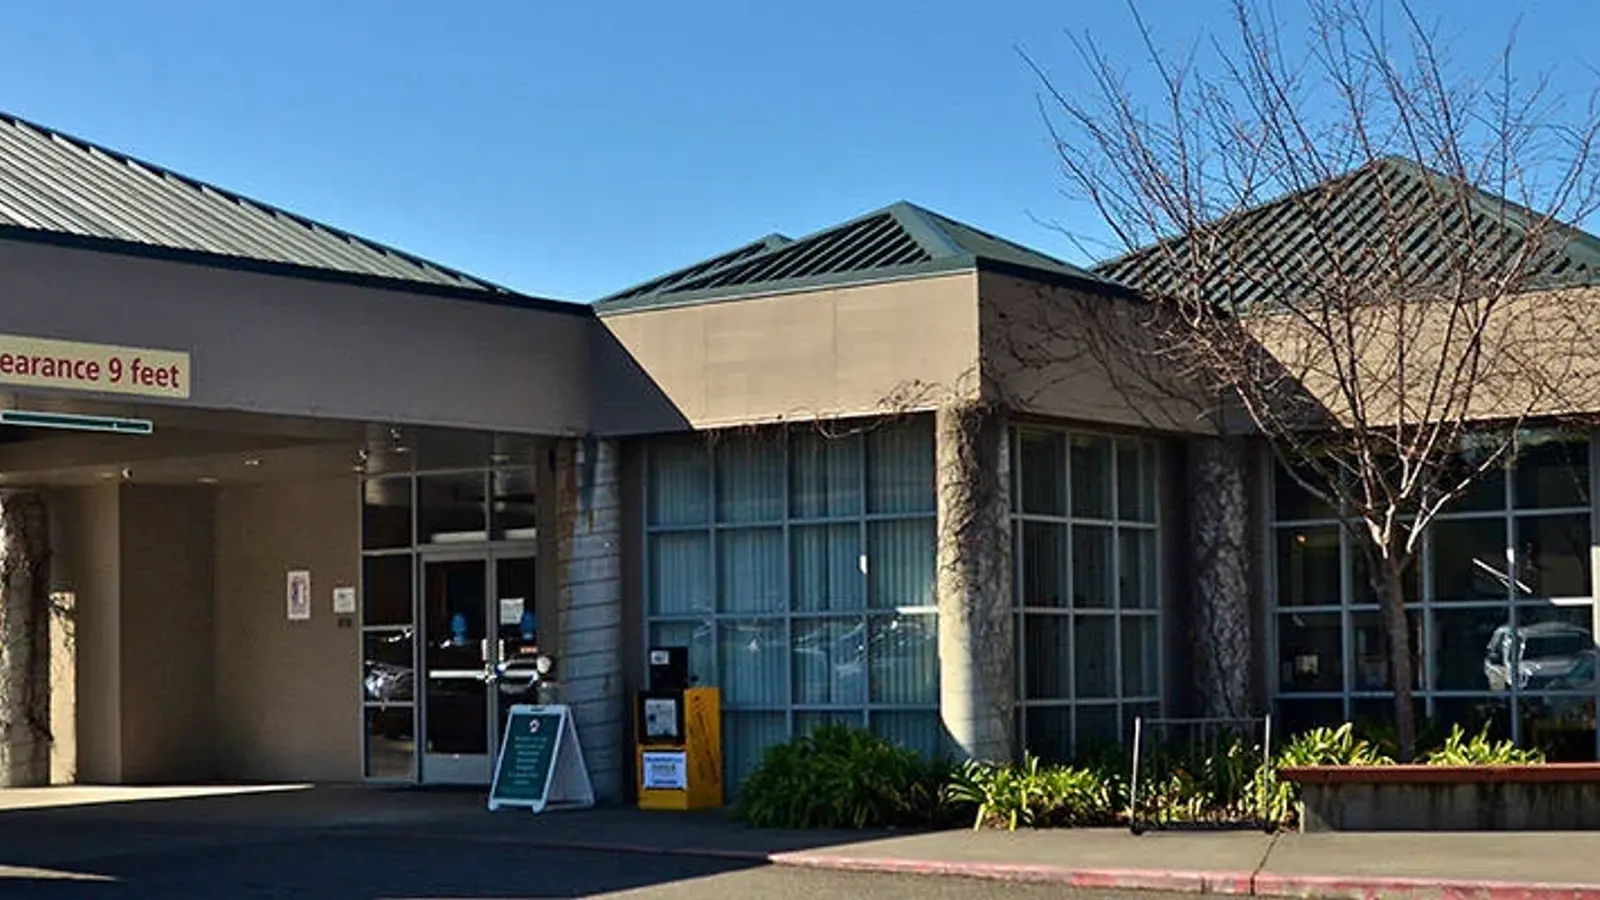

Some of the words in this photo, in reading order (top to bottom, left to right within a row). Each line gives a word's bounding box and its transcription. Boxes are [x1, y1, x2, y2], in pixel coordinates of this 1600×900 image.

[0, 353, 100, 381] earance
[108, 357, 122, 382] 9
[130, 358, 179, 387] feet
